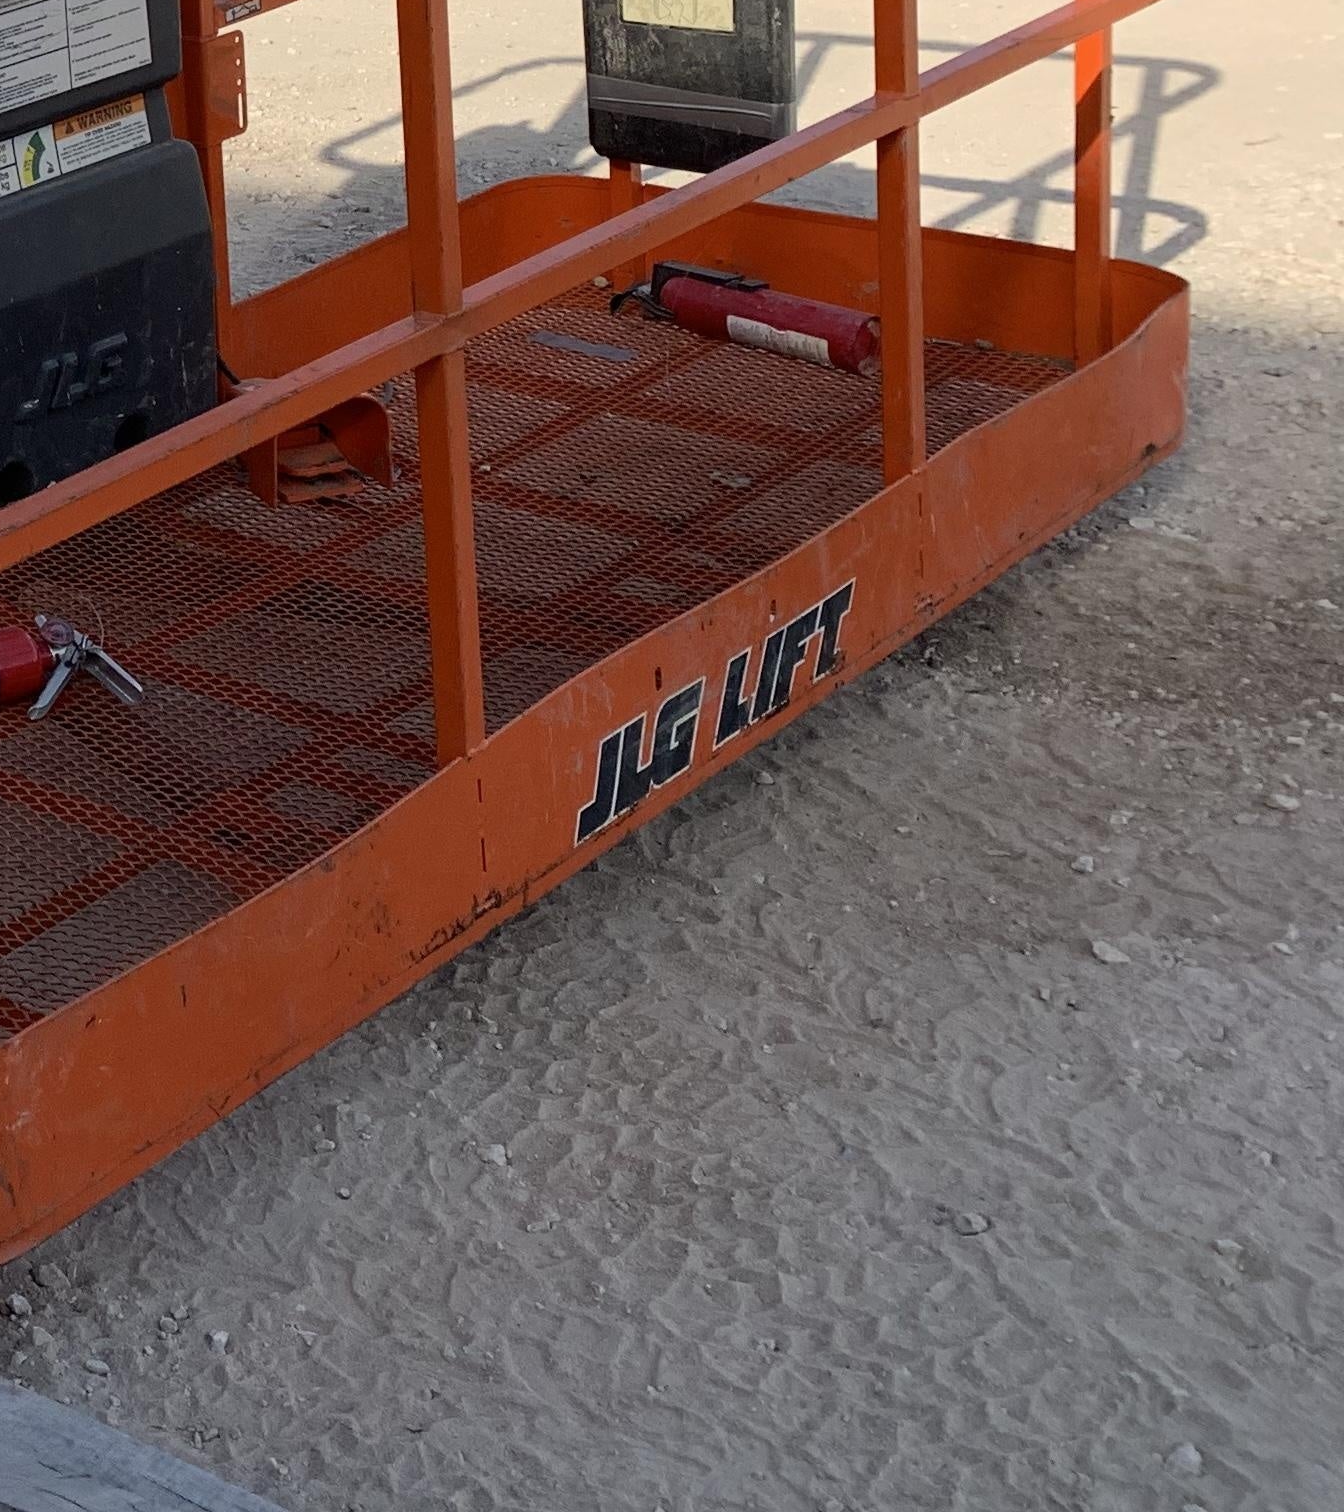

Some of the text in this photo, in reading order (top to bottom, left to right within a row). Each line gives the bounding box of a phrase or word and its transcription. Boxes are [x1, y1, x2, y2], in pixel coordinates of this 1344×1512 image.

[77, 100, 132, 129] WARNING
[574, 577, 857, 849] JLG LIFT
